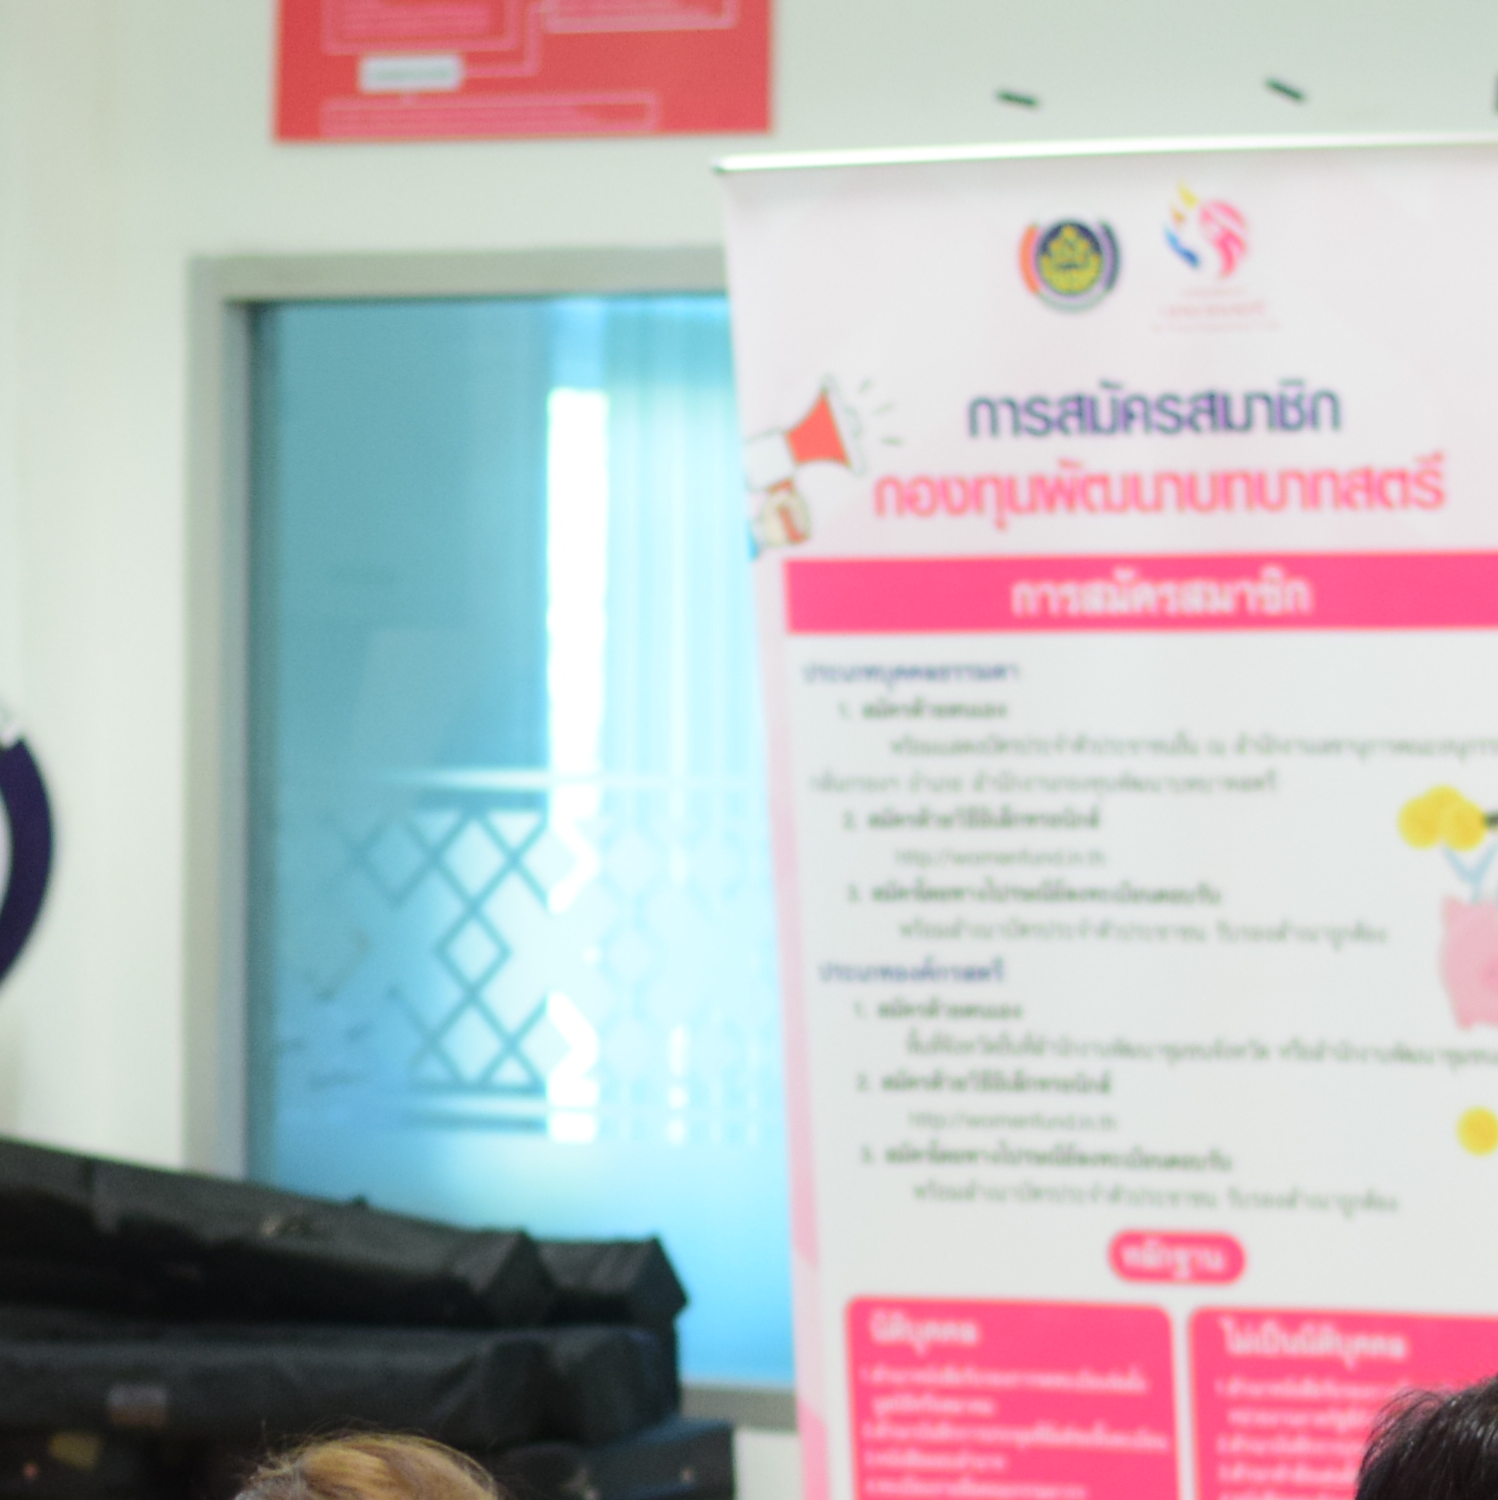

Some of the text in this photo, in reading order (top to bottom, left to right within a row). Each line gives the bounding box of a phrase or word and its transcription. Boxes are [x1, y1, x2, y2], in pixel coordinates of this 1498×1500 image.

[968, 380, 1341, 439] การสมัครสมาชิก
[875, 453, 1445, 532] กองทุนพัฒนาบทบาทสตรี
[1011, 567, 1313, 621] การสมัครสมาชิก
[1121, 1236, 1226, 1279] หลักฐาน
